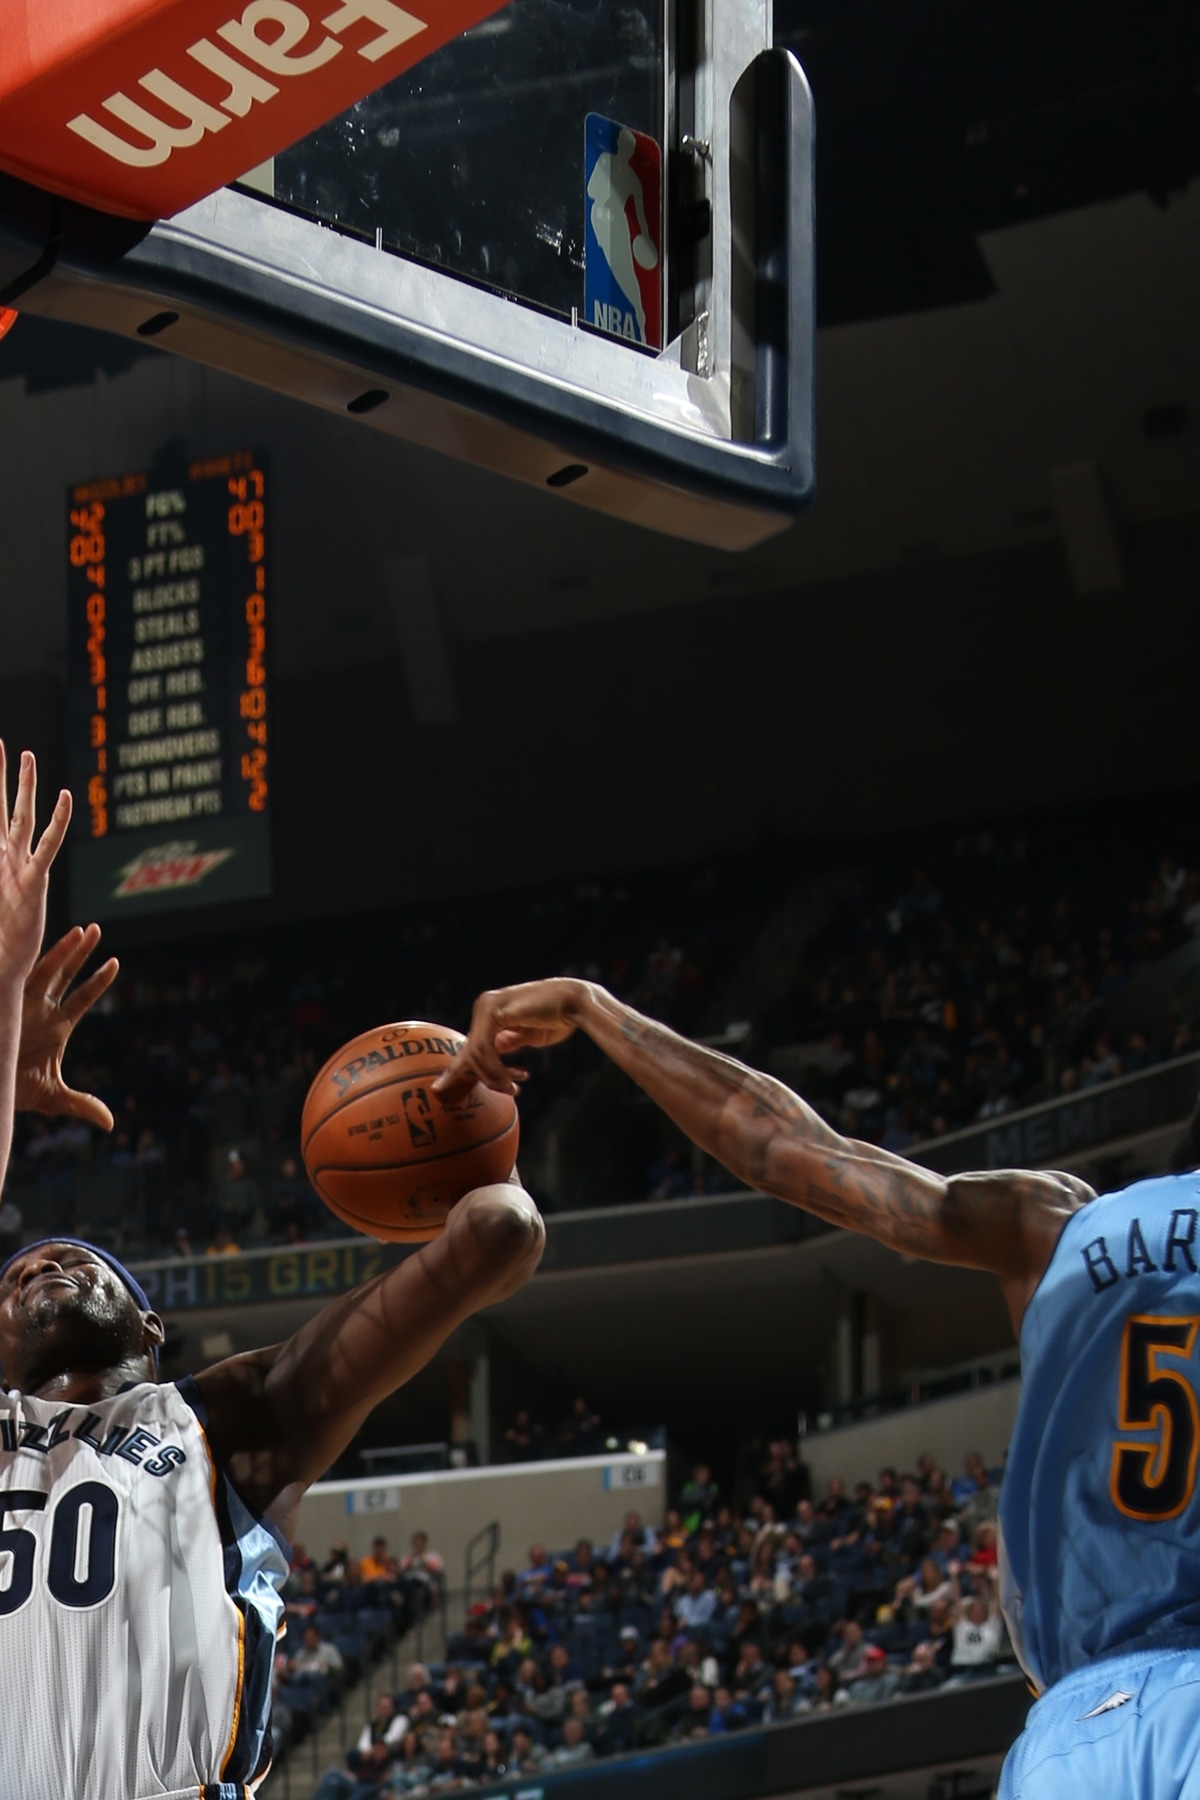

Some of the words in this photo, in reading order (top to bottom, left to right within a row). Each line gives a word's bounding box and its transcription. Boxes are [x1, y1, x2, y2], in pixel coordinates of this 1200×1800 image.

[66, 0, 428, 167] Farm
[594, 299, 636, 341] NBA
[228, 469, 264, 500] 47
[133, 579, 199, 614] BLOCKS
[134, 607, 199, 643] STEALS
[131, 638, 203, 673] ASSISTS
[118, 728, 220, 768] TURNOVERS
[150, 768, 170, 795] IN
[172, 758, 221, 790] PAINT
[331, 1037, 464, 1098] SPALDIN
[1109, 1315, 1200, 1521] 5
